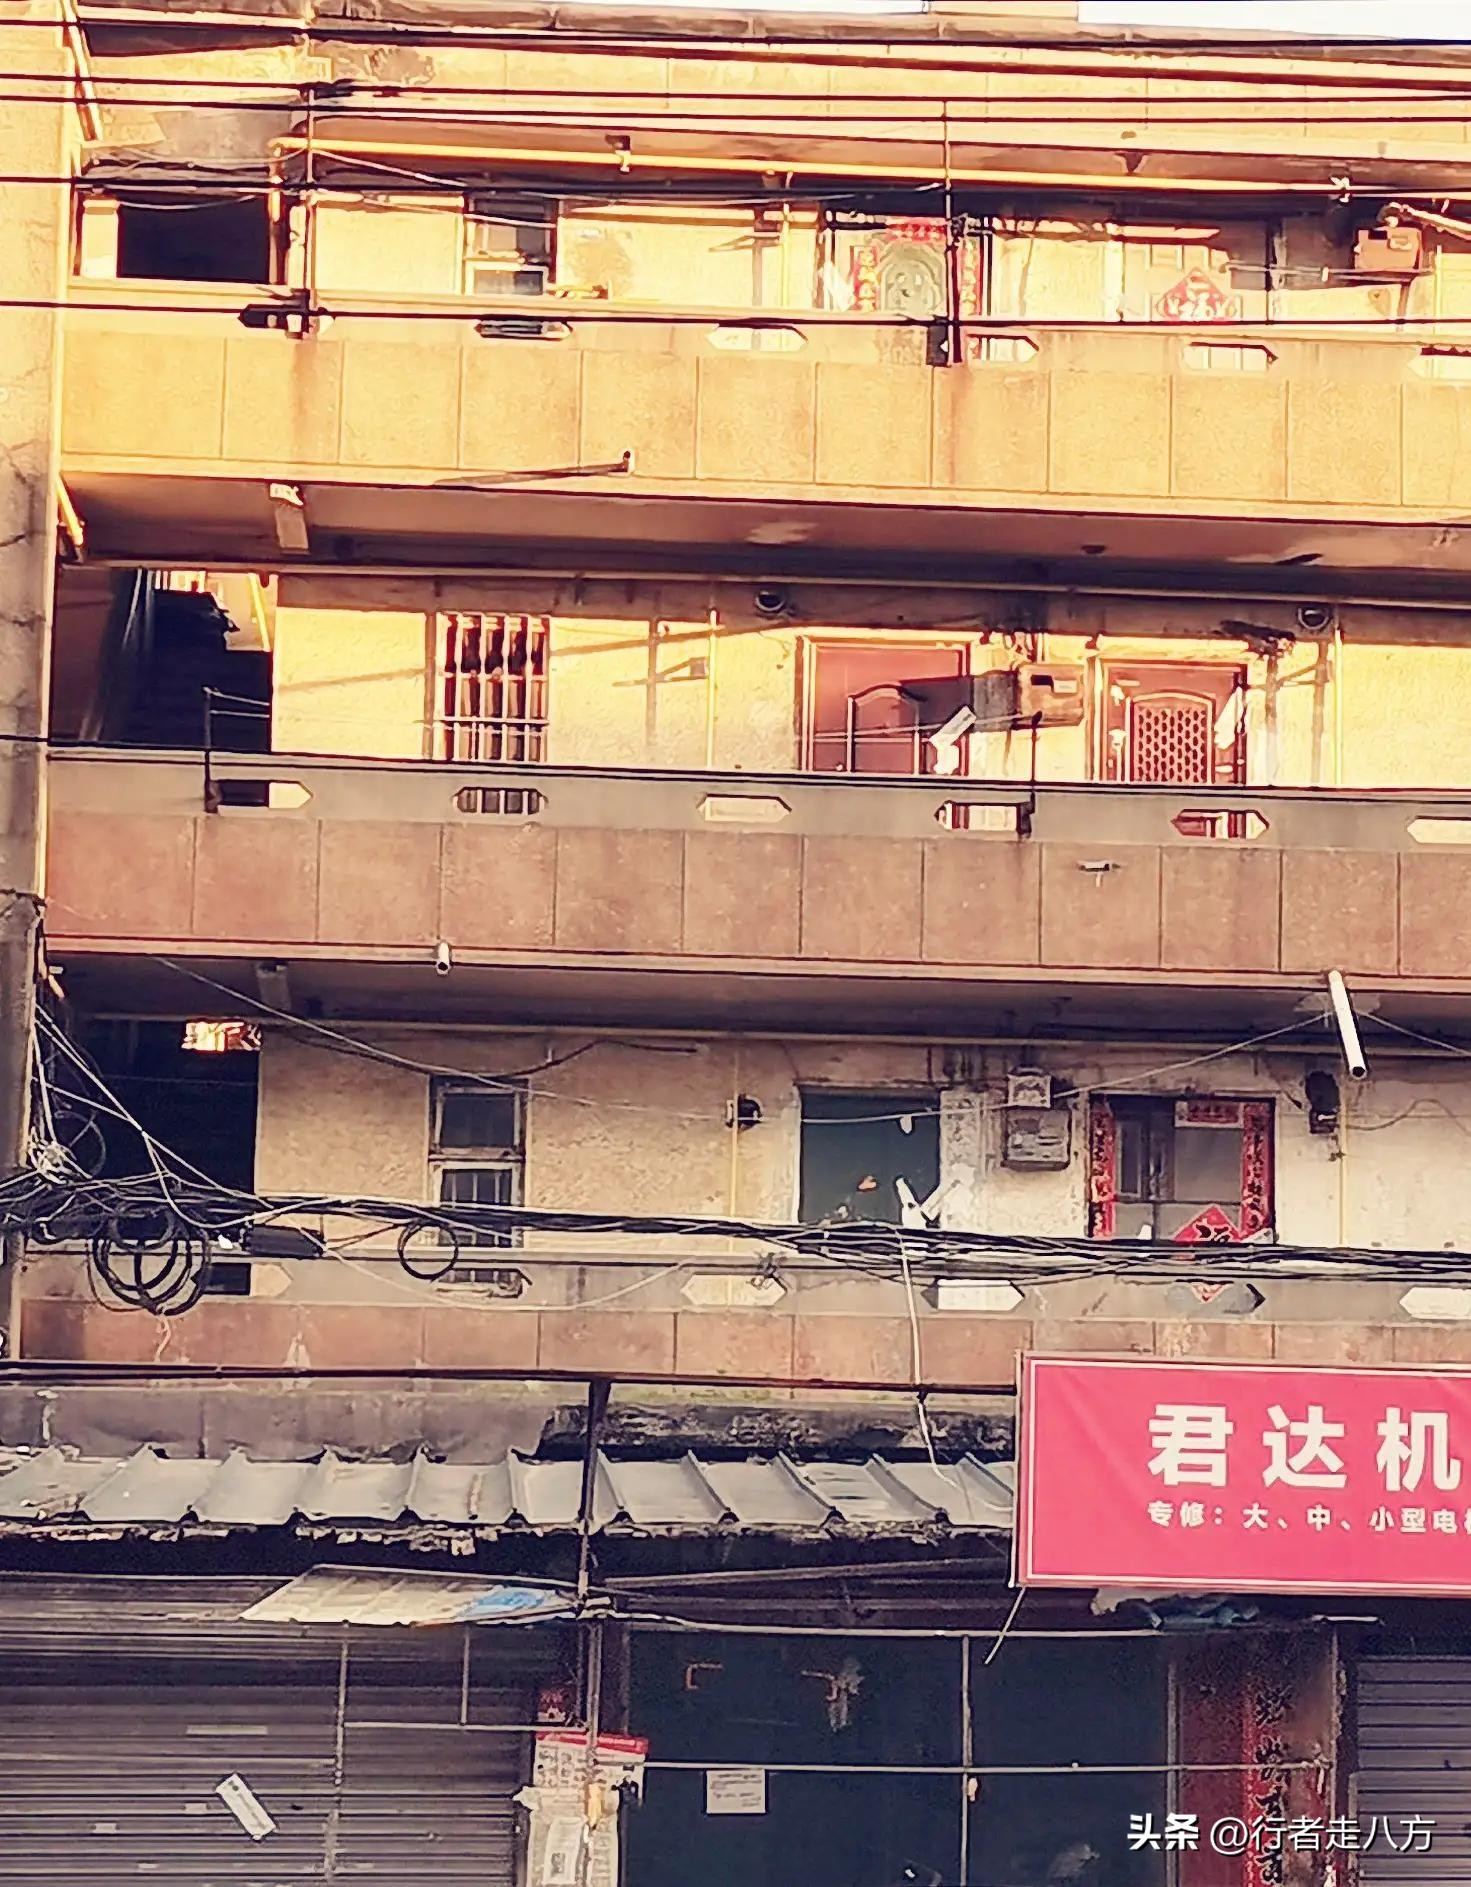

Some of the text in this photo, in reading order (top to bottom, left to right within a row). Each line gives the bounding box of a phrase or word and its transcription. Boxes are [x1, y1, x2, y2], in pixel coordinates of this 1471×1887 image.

[1147, 1404, 1461, 1492] 君达机
[1147, 1501, 1471, 1535] 专修：大、中、小型电
